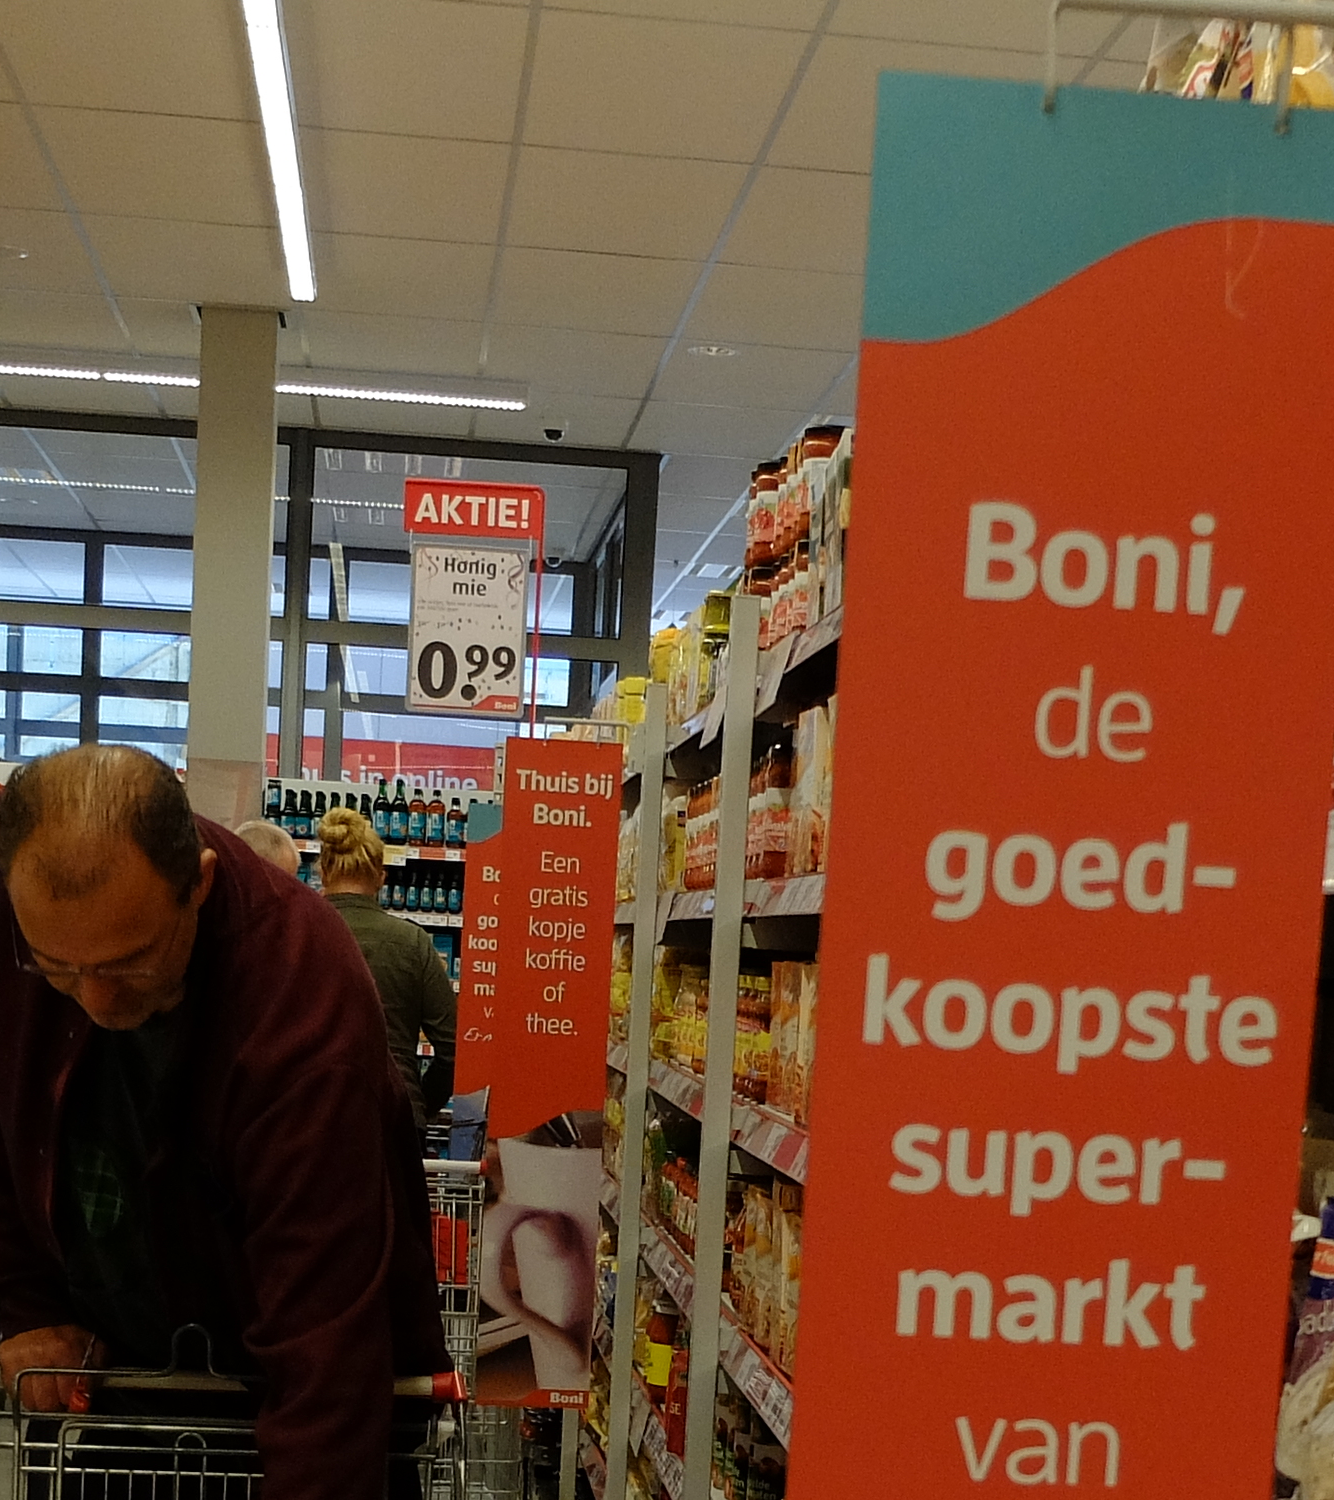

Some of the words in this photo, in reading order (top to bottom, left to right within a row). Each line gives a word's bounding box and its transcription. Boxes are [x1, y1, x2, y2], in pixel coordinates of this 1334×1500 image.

[414, 493, 529, 529] AKTIE!
[444, 556, 497, 580] Honig
[963, 500, 1246, 637] Boni,
[453, 579, 487, 597] mie
[1034, 665, 1154, 764] de
[516, 768, 579, 796] Thuis
[585, 770, 614, 800] bij
[533, 803, 592, 828] Boni.
[541, 852, 580, 874] Een
[925, 822, 1238, 922] goed-
[529, 886, 589, 909] gratis
[528, 915, 586, 943] kopje
[526, 950, 586, 973] koffie
[543, 981, 566, 1003] of
[526, 1013, 579, 1036] thee.
[862, 953, 1279, 1074] koopste
[889, 1122, 1226, 1217] super-
[895, 1259, 1206, 1350] markt
[956, 1416, 1121, 1486] van
